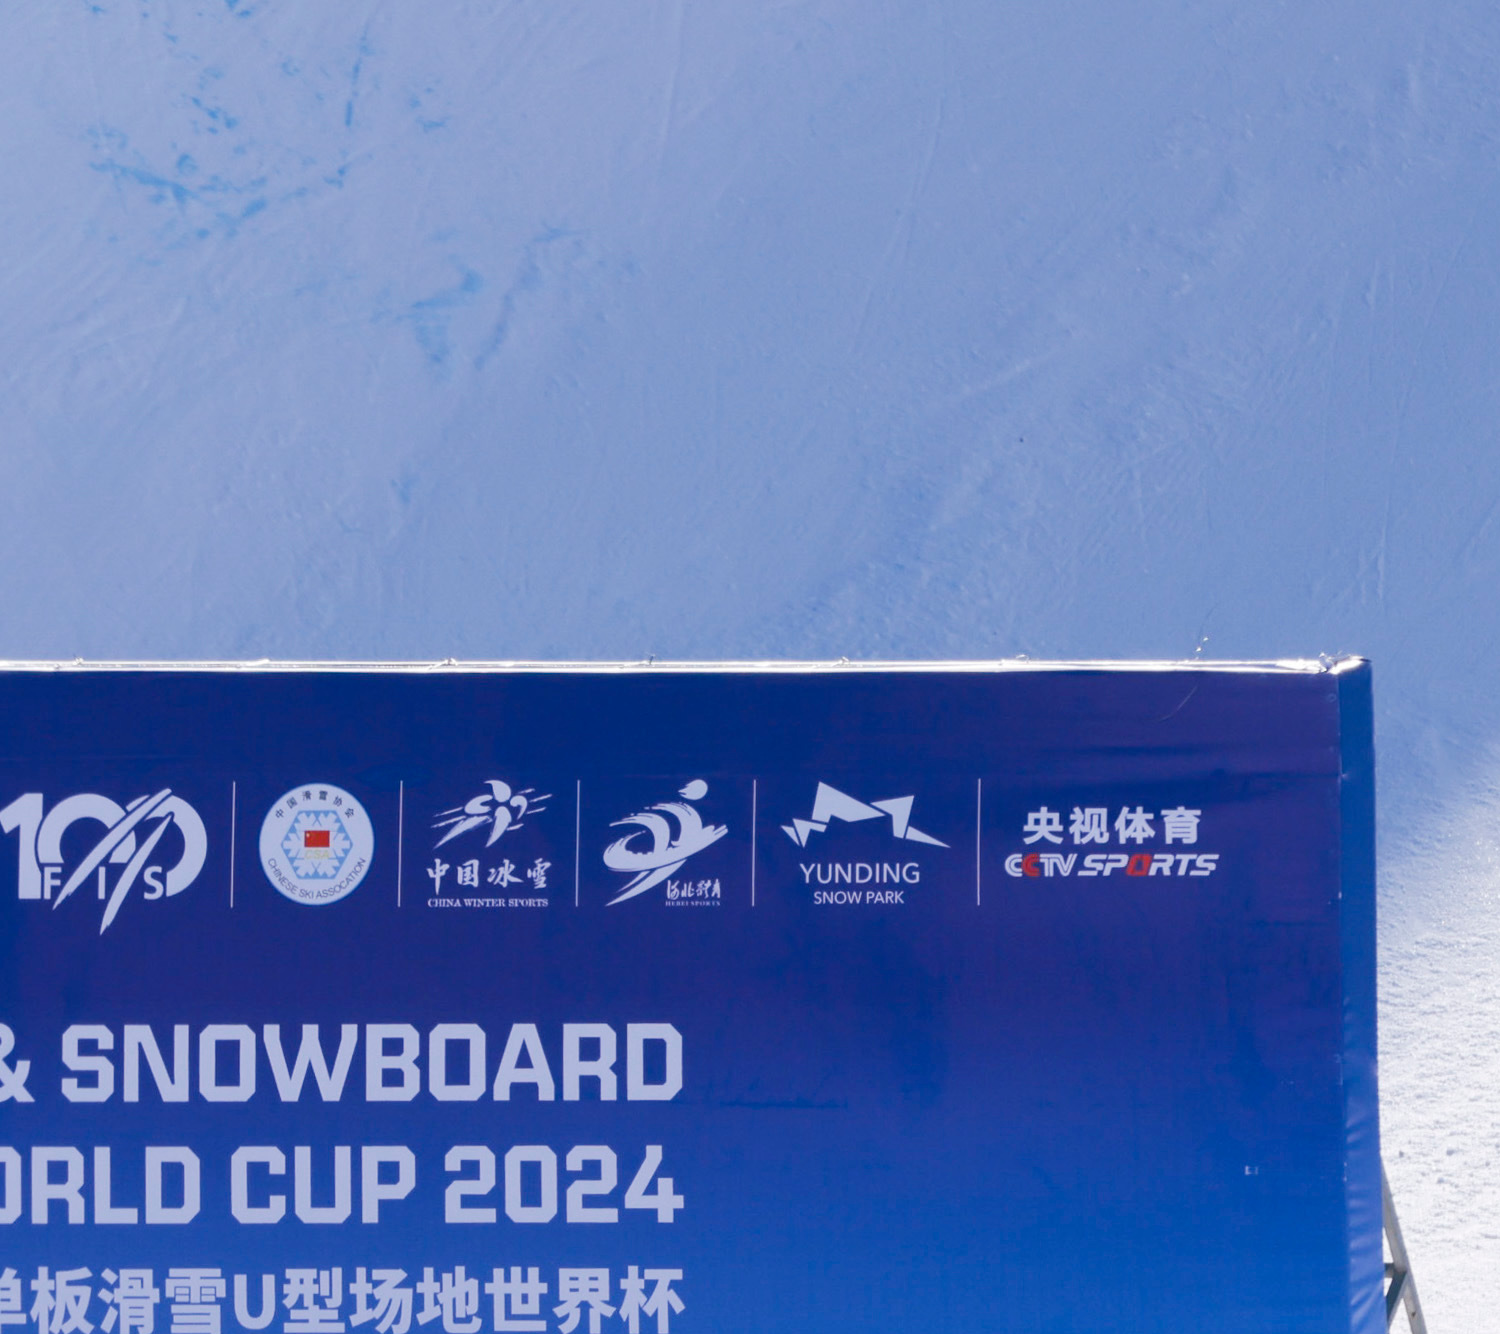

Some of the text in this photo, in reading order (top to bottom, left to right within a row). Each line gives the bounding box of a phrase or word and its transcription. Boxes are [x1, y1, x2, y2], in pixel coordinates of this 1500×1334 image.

[1023, 805, 1202, 845] 央视体育
[426, 857, 552, 895] 中国冰雪
[799, 862, 920, 884] YUNDING
[1005, 853, 1219, 877] CCTV SPORTS
[428, 898, 549, 908] CHINA WINTER SPORTS
[814, 891, 904, 905] SNOW PARK
[61, 1022, 683, 1103] SNOWBOARD
[230, 1145, 416, 1225] CUP
[444, 1144, 685, 1224] 2024
